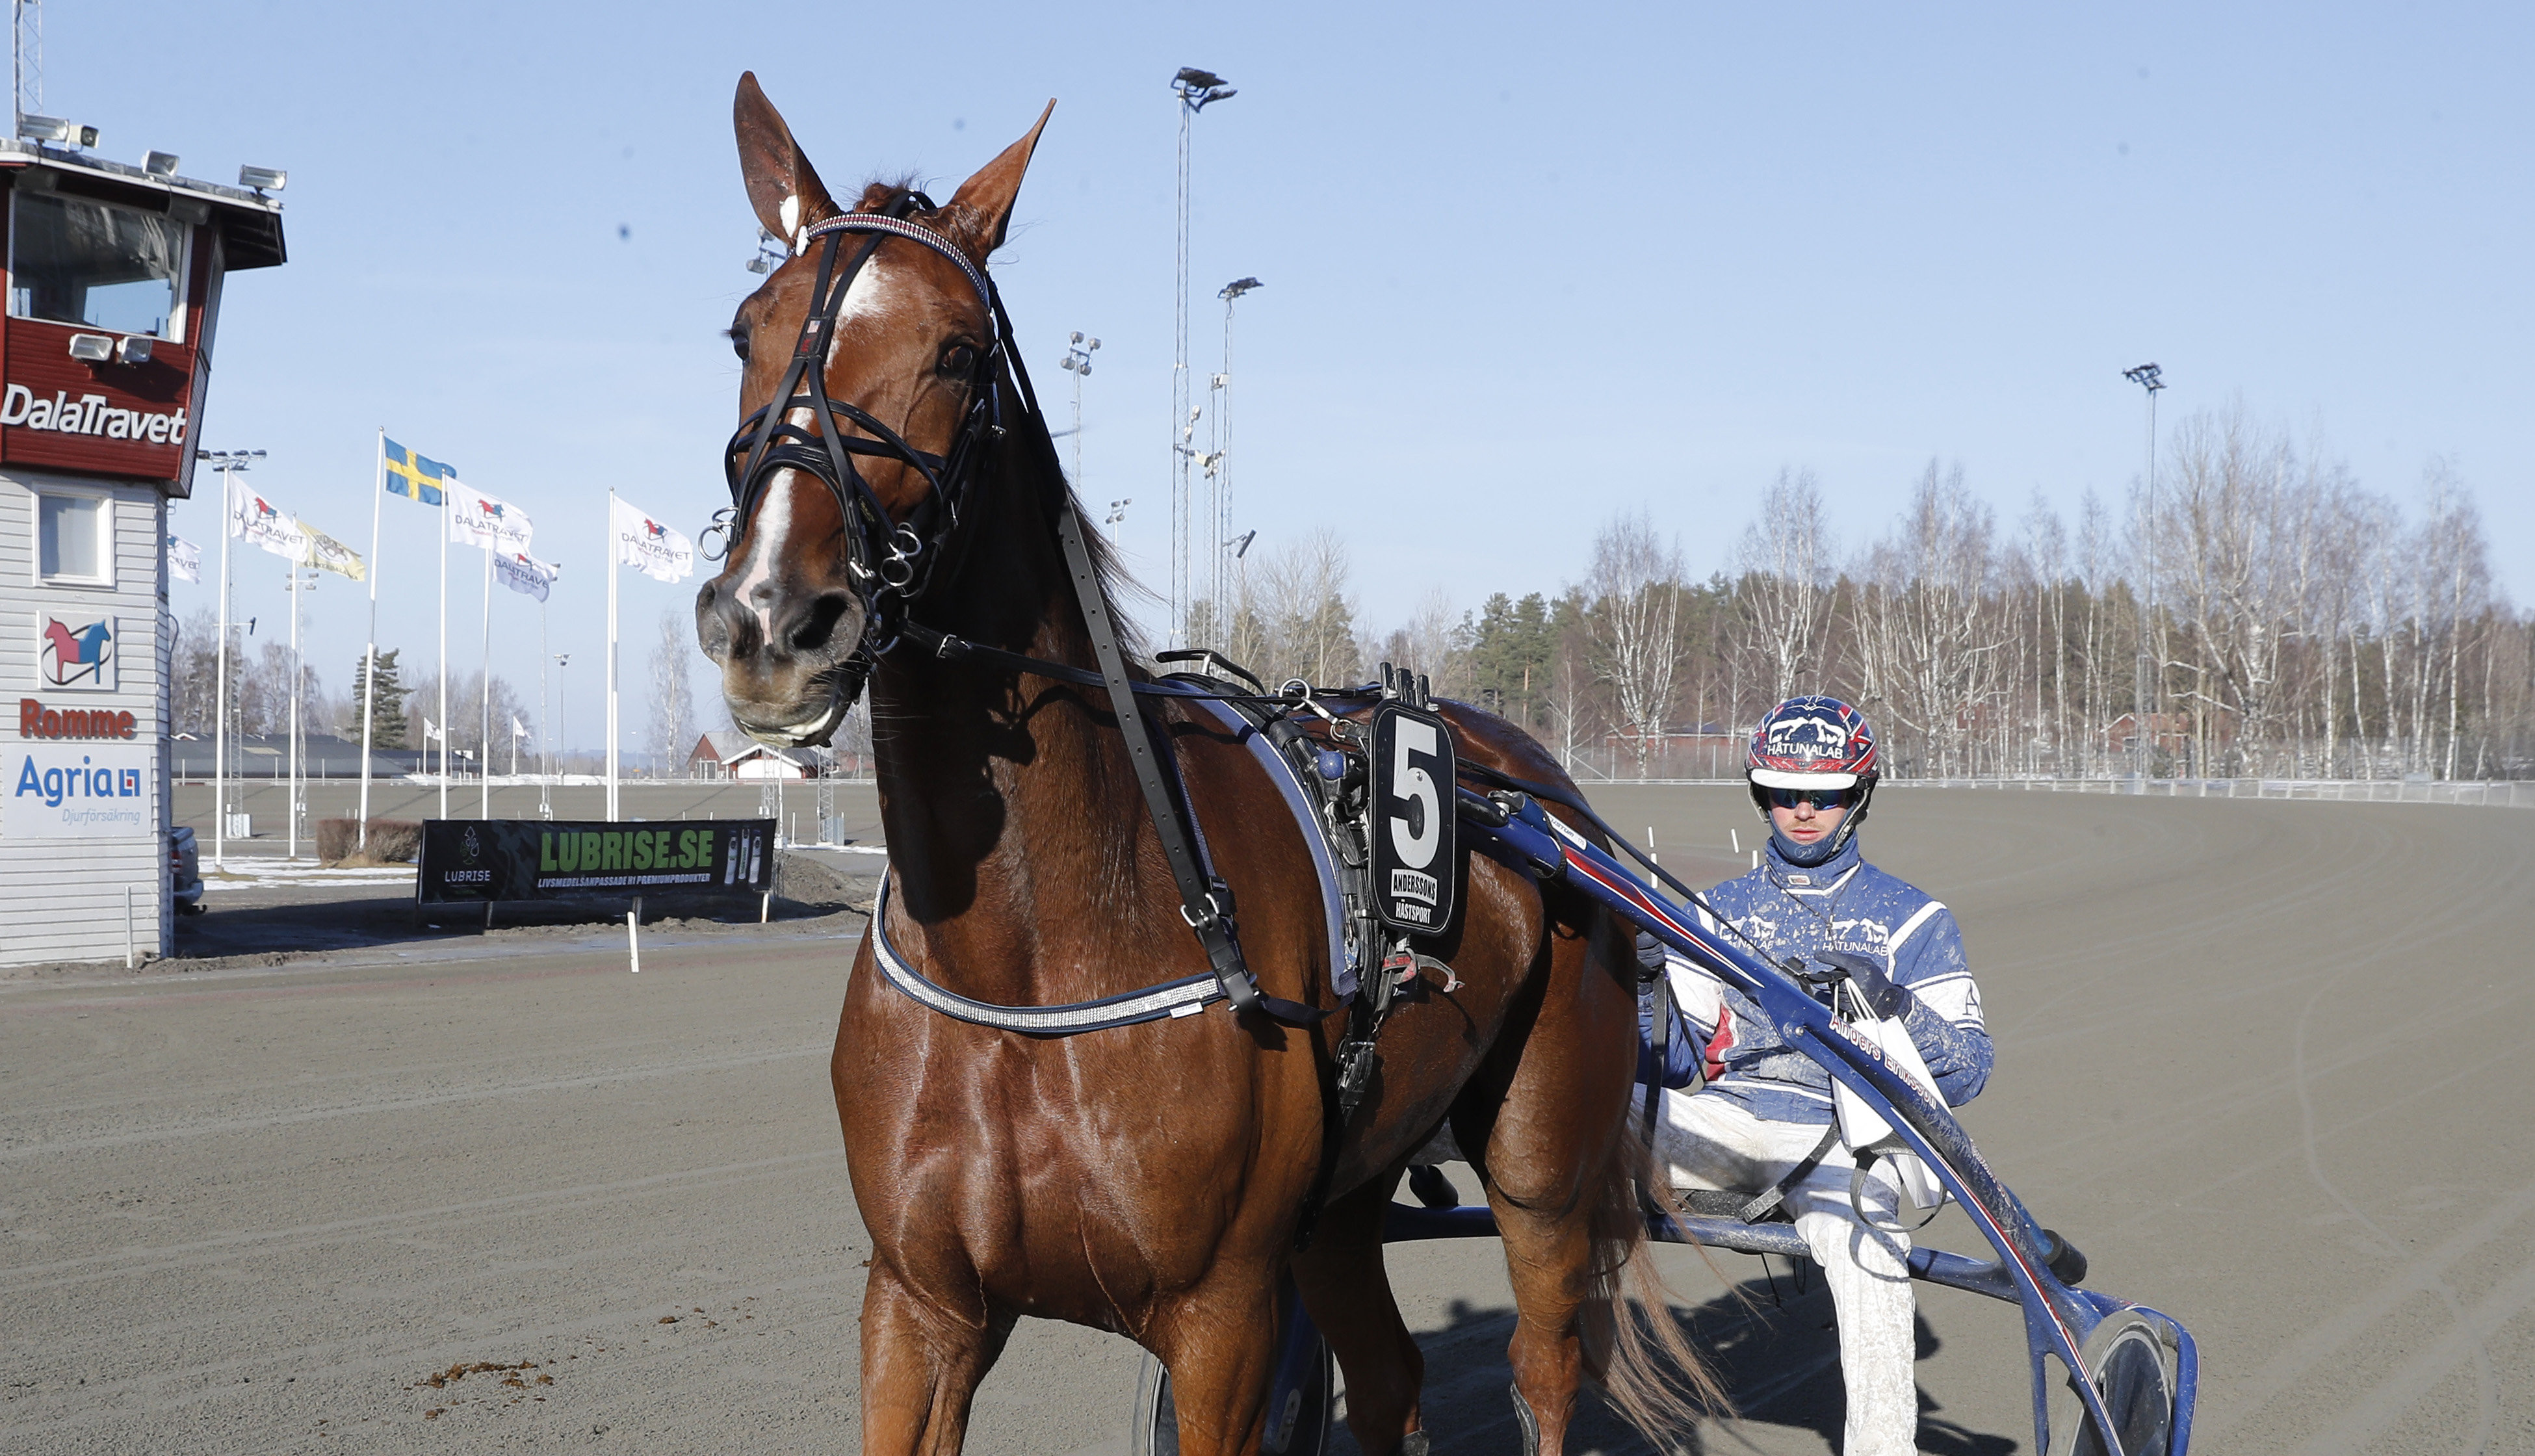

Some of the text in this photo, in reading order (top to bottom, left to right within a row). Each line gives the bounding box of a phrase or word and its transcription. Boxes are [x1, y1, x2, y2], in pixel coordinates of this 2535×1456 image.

[1, 384, 187, 445] DalaTravet
[455, 515, 527, 541] DALATRAVET
[621, 533, 690, 560] DALATRAVET
[20, 698, 134, 738] Romme
[1767, 742, 1843, 759] HÅTUNALAB
[15, 755, 114, 807] Agria
[1390, 715, 1440, 869] 5
[62, 808, 140, 826] Djurförsäkring
[540, 829, 714, 872] LUBRISE.SE
[445, 870, 491, 882] LUBRISE
[636, 874, 711, 885] PREMIUMPRODUKTER
[1394, 874, 1435, 900] ANDERSSONS
[1396, 899, 1431, 924] HÄSTSPORT
